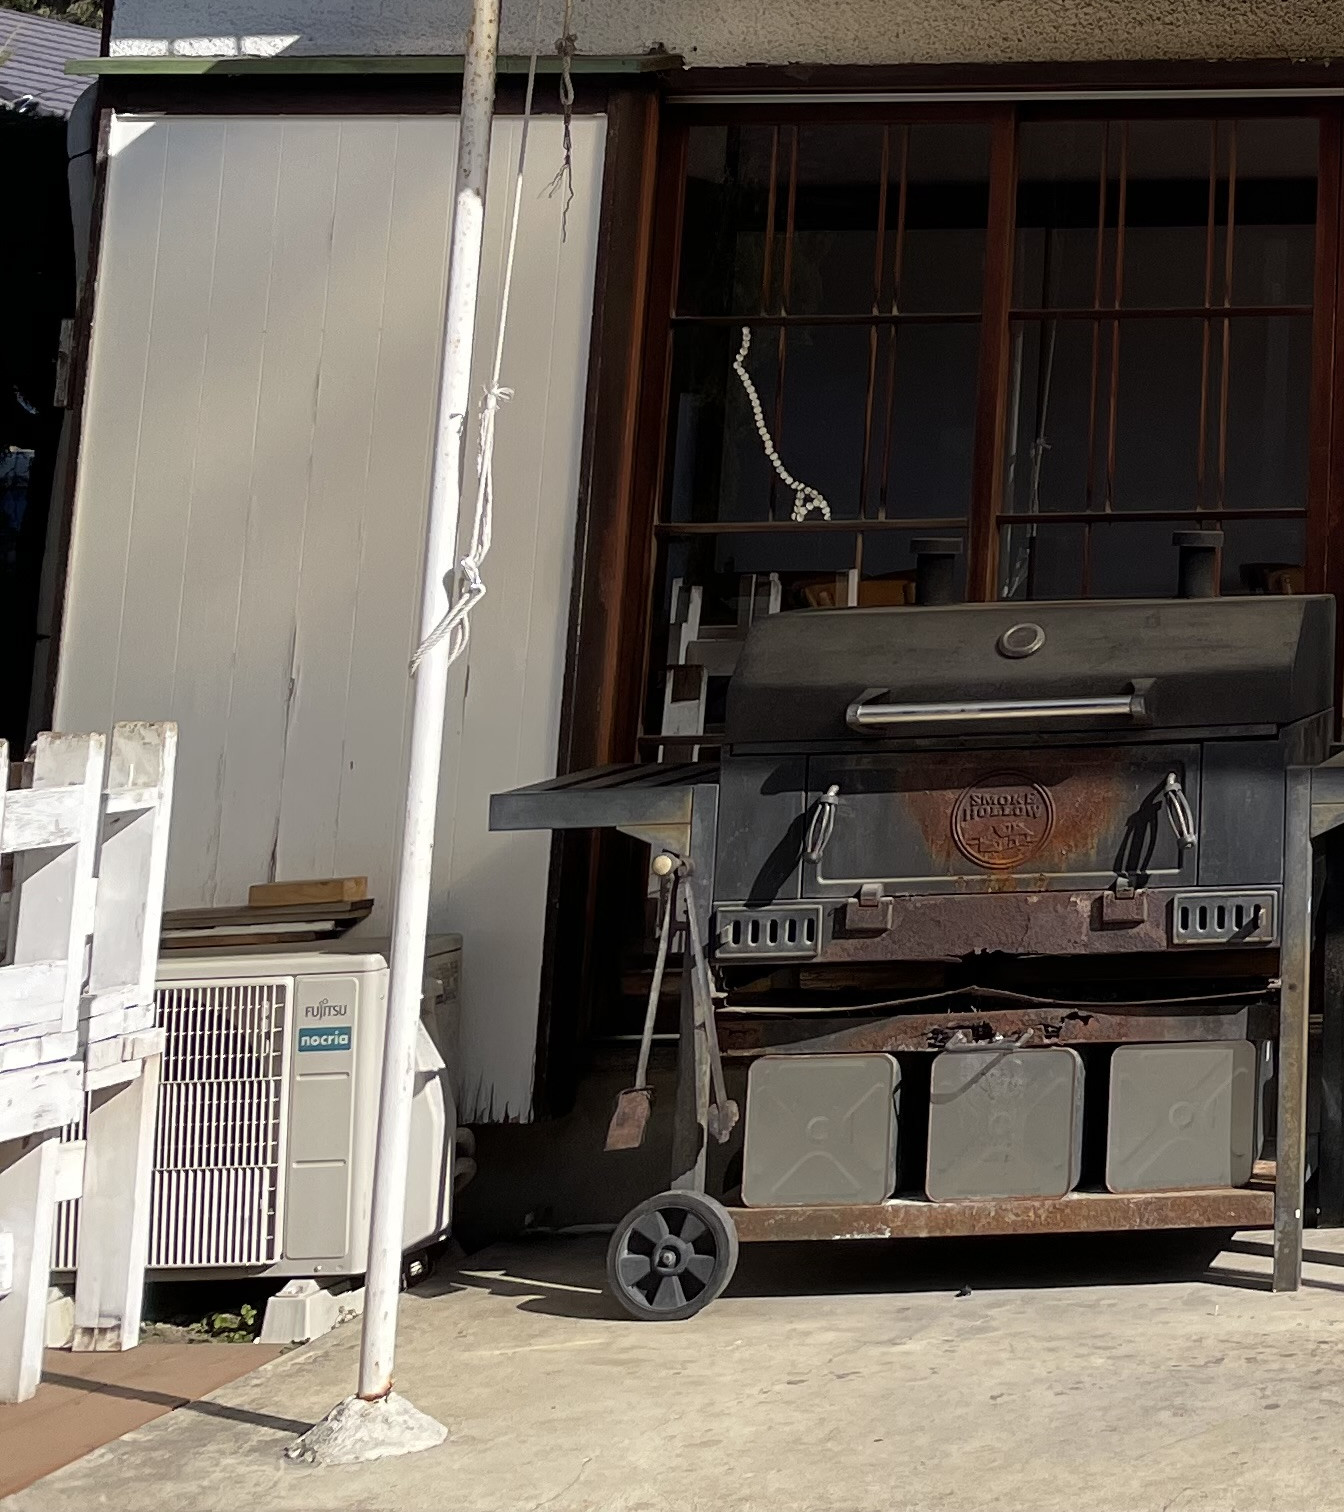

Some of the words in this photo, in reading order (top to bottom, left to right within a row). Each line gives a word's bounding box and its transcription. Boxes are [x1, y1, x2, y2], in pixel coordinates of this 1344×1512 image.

[969, 793, 1036, 807] SMOKE
[963, 805, 1040, 822] HOLLOW
[305, 998, 348, 1020] FUJITSU
[300, 1030, 350, 1047] nocria
